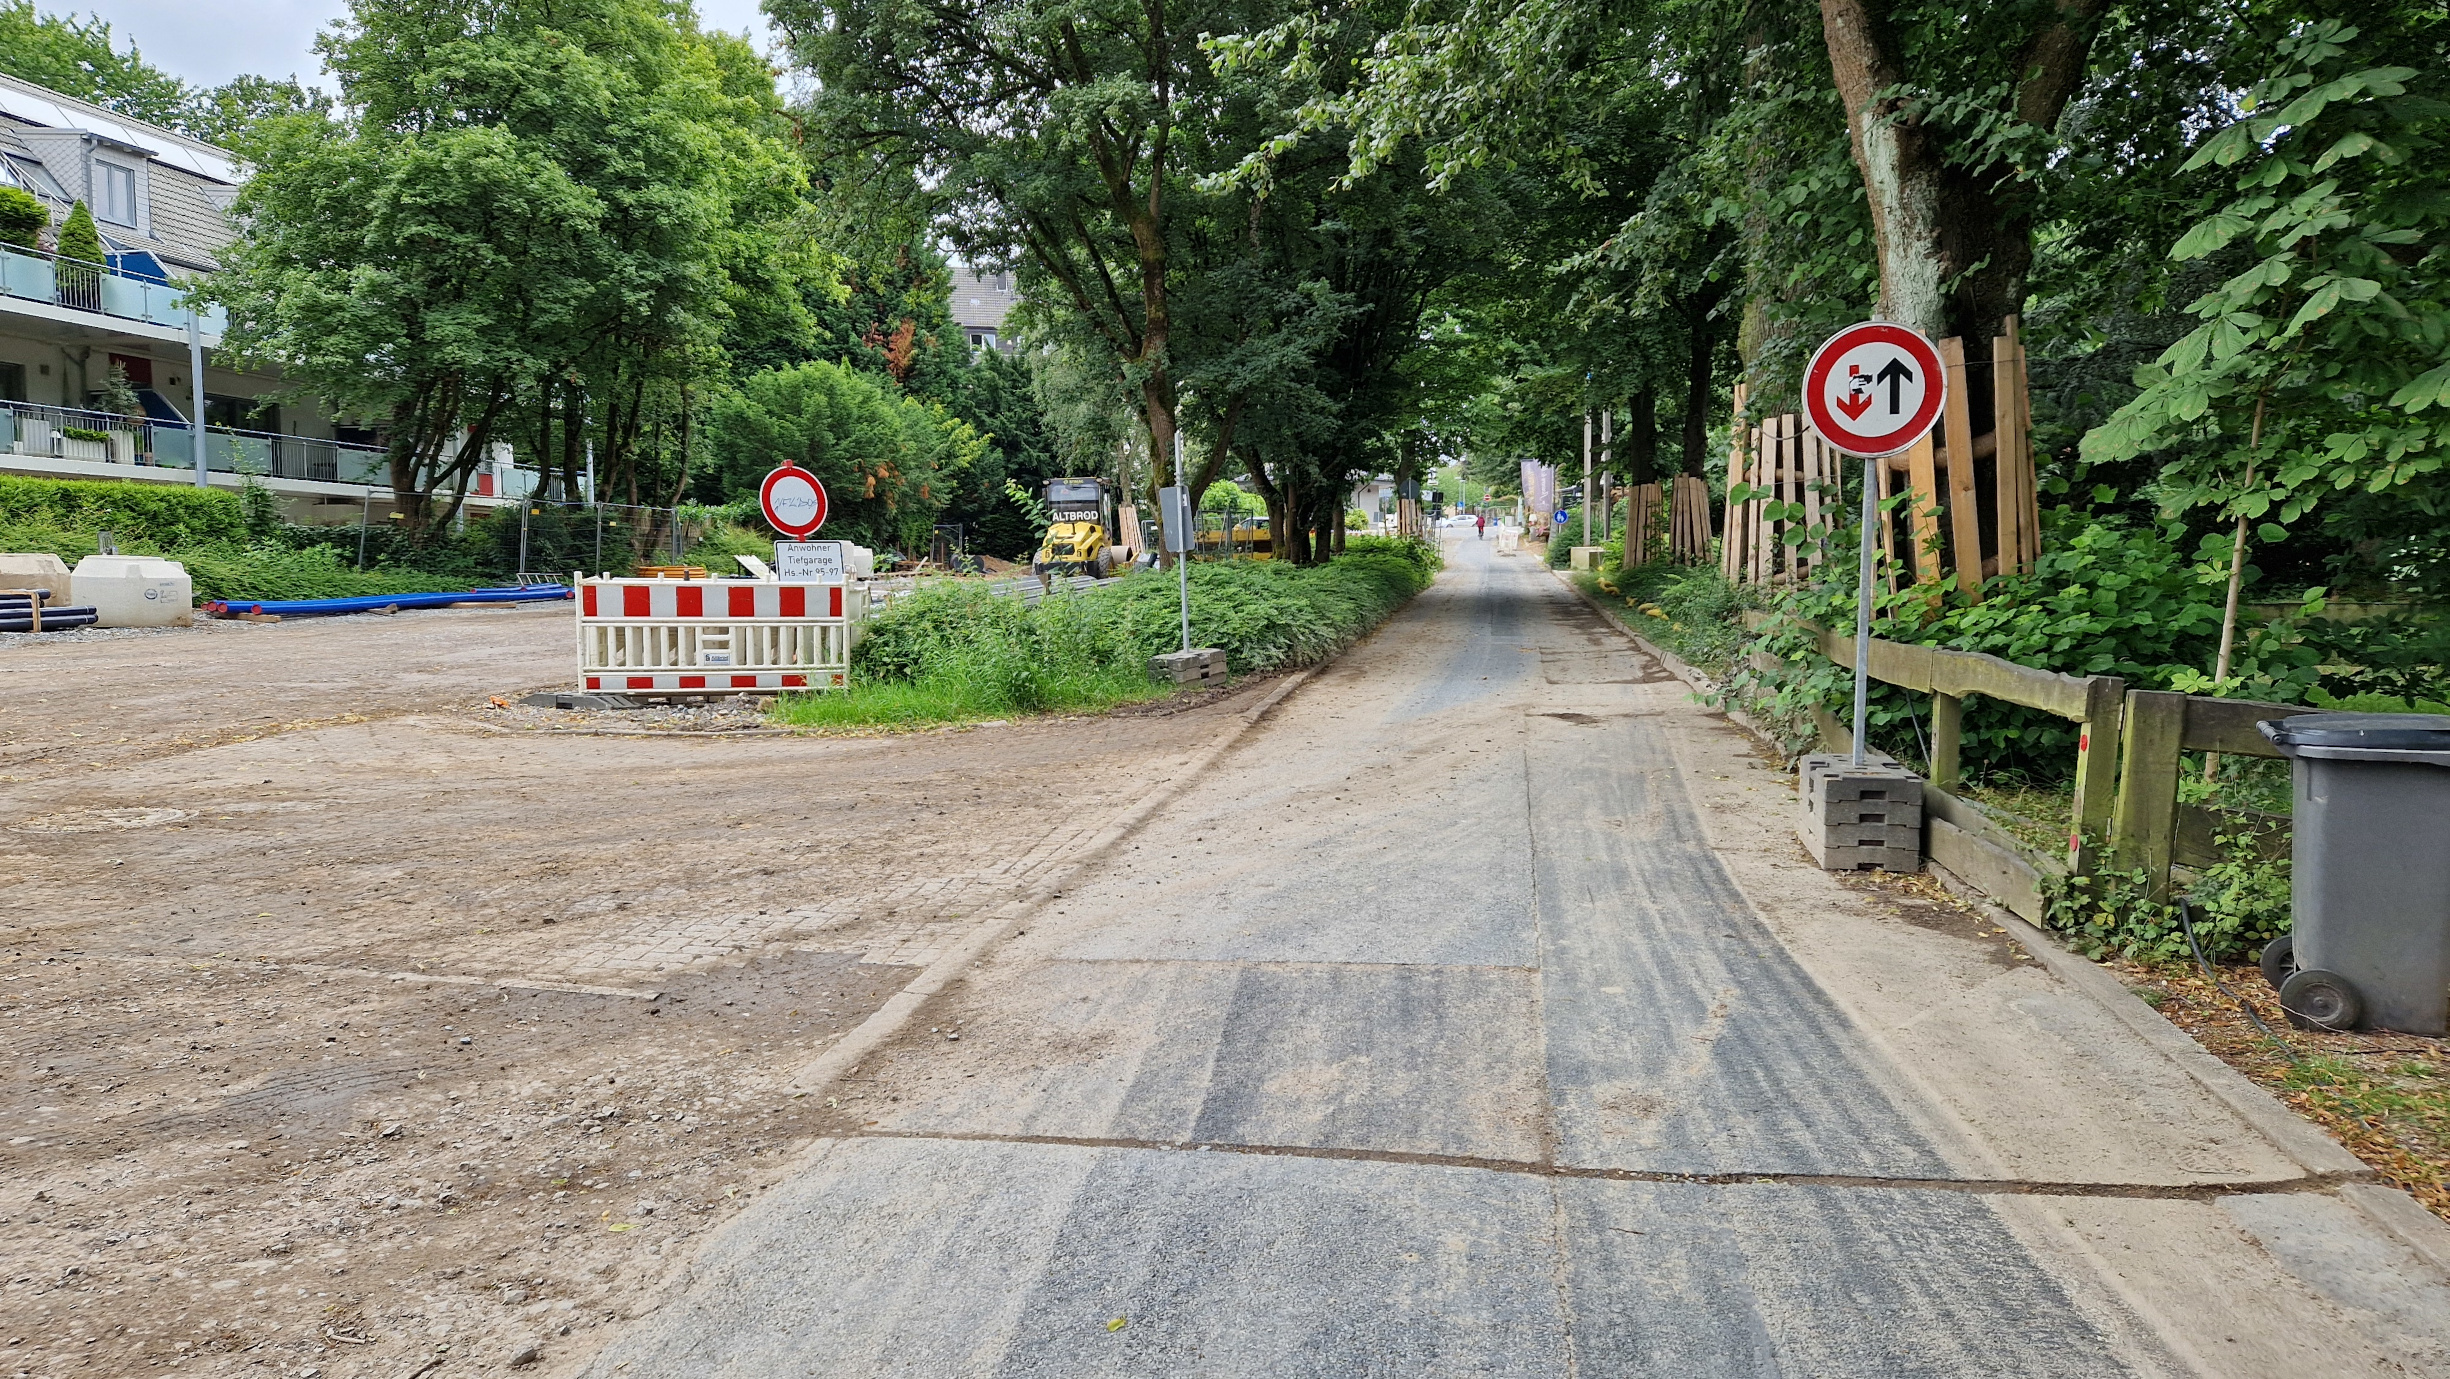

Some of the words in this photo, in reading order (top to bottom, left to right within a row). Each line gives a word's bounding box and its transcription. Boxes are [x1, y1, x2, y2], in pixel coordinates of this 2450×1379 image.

[1052, 511, 1098, 521] ALTBROD
[787, 544, 831, 552] Anwohner
[788, 556, 832, 566] Tiefgarage
[815, 568, 838, 576] 95-97
